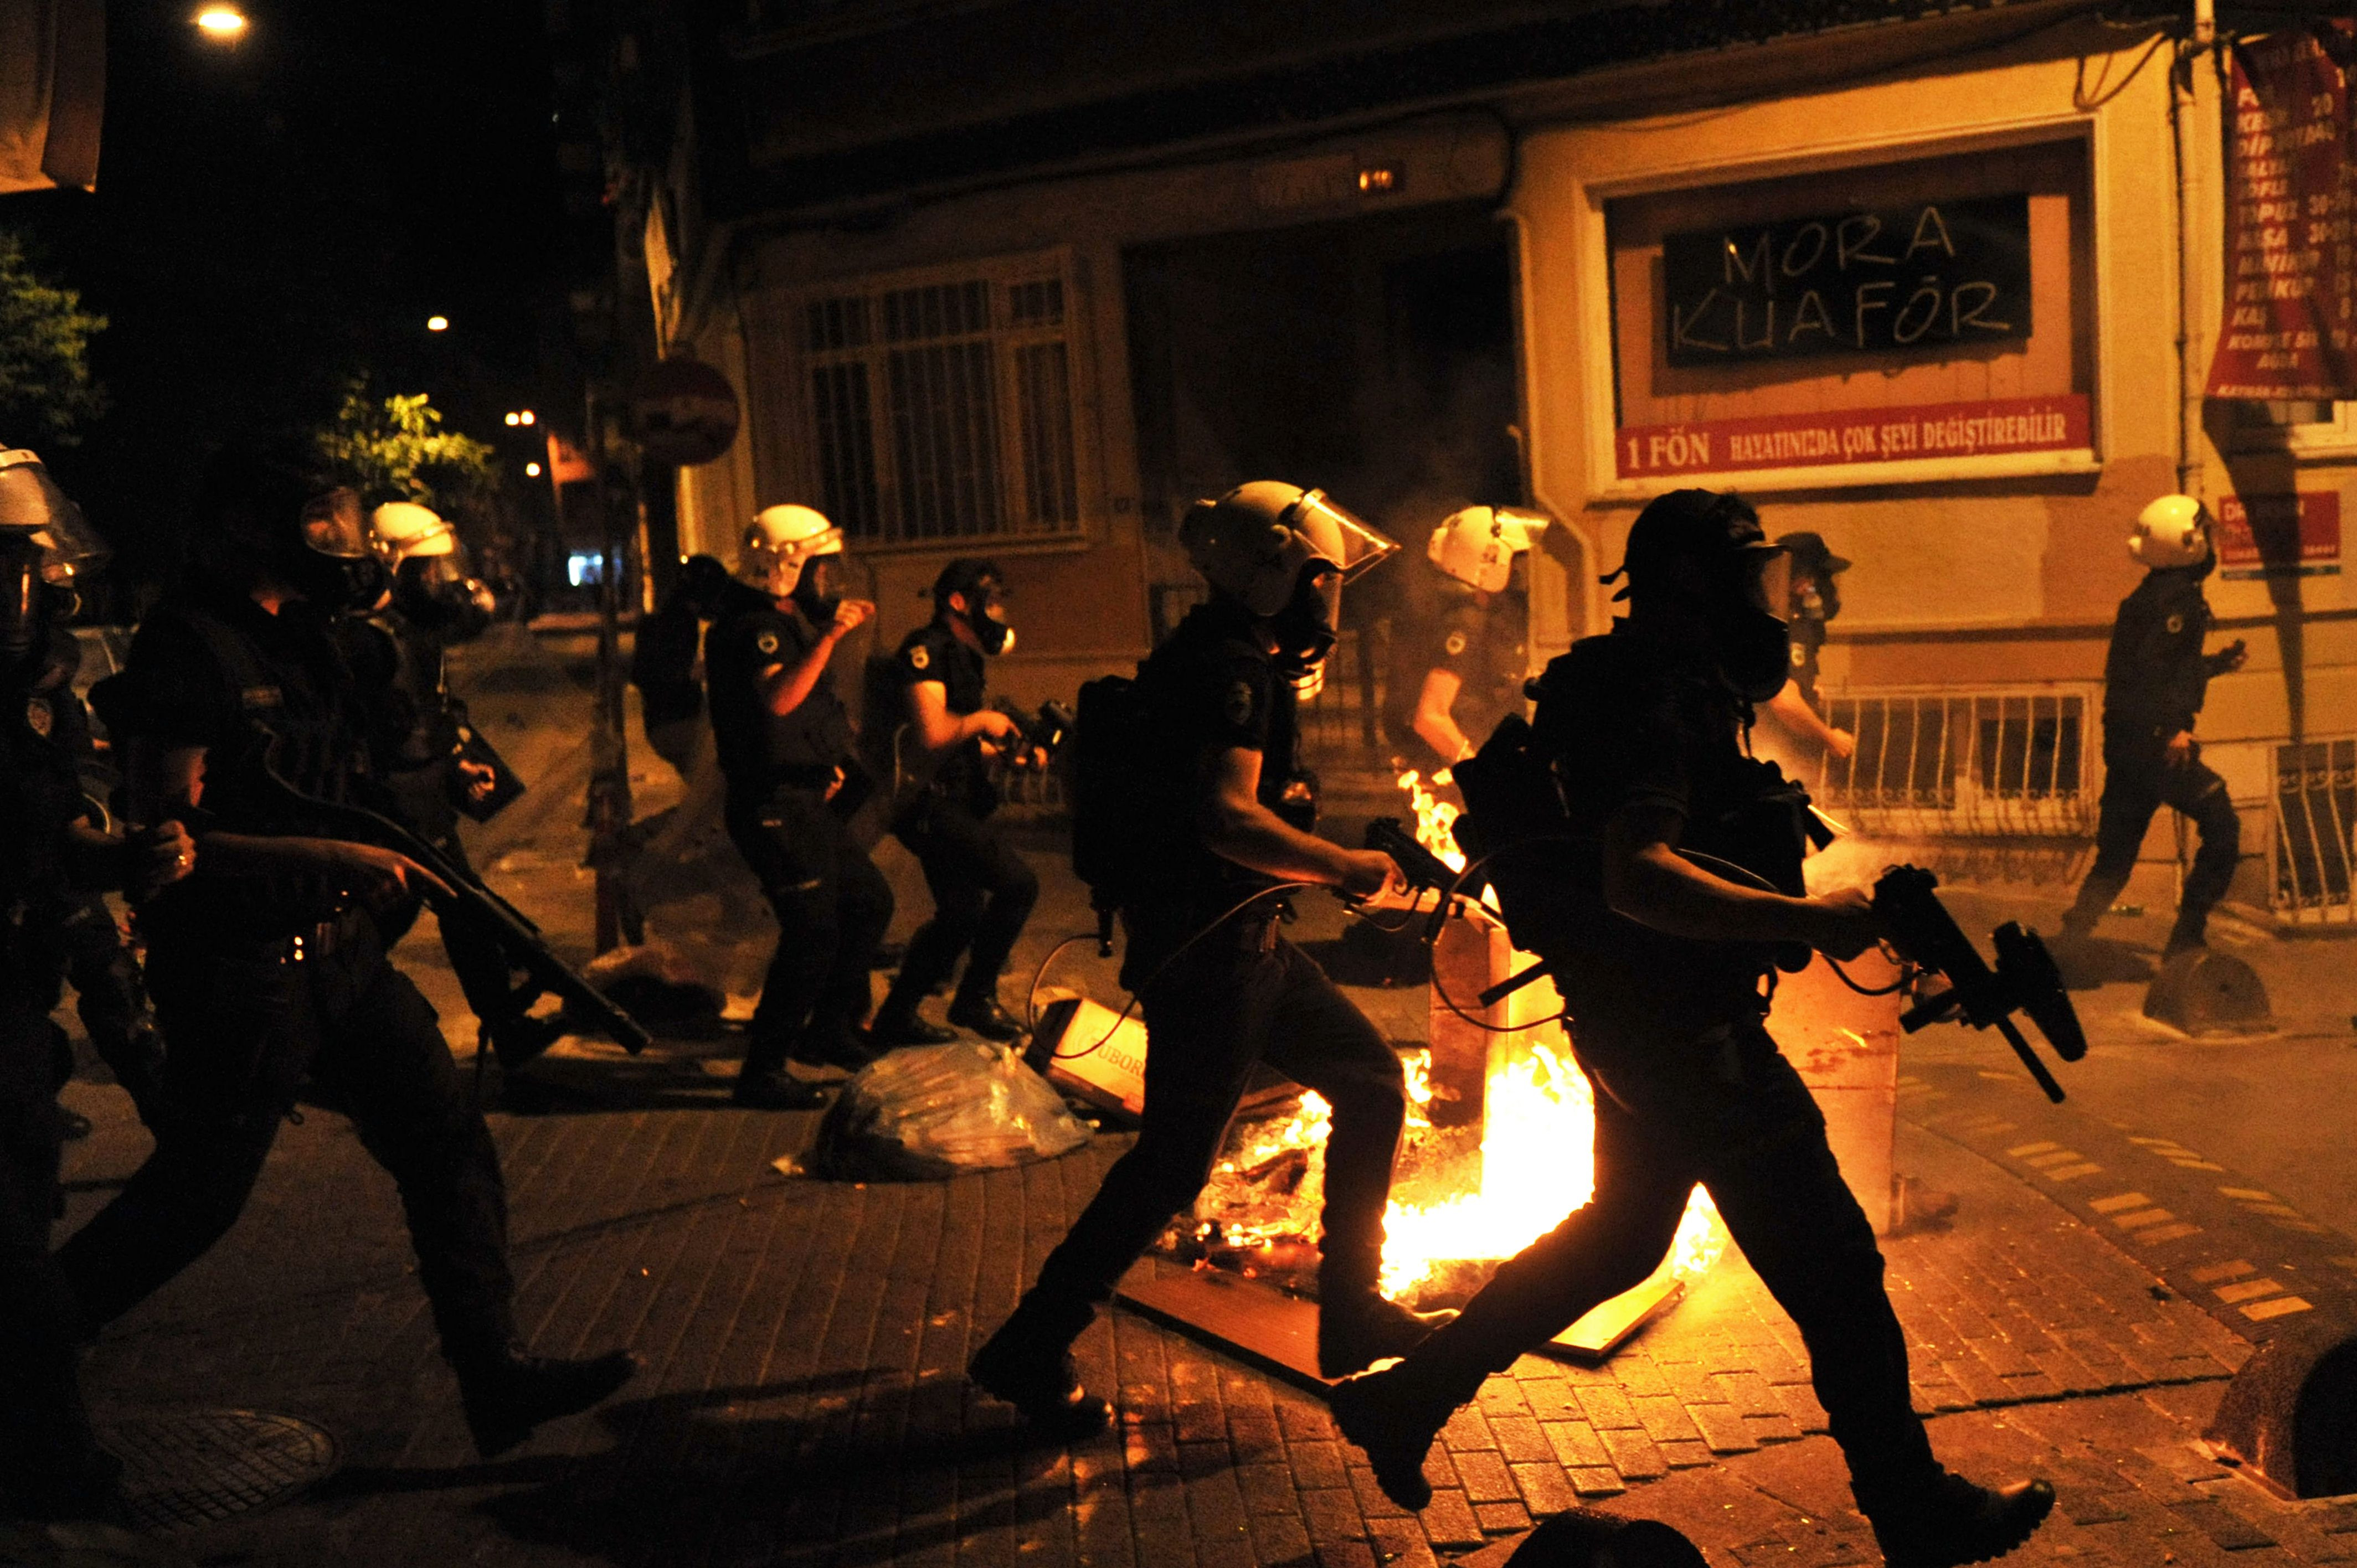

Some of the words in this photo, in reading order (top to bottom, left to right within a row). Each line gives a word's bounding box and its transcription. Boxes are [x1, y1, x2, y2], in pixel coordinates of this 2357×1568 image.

[1723, 206, 1956, 293] MORA
[1673, 276, 2011, 350] KUAFÖR
[1627, 436, 1641, 469] 1
[1649, 426, 1710, 468] FÖN
[1843, 425, 1876, 461] ÇOK
[1882, 416, 1917, 458] ŞEYİ
[1923, 406, 2066, 453] DEĞİŞTİREBİLİR
[1090, 1036, 1144, 1076] TUBOR
